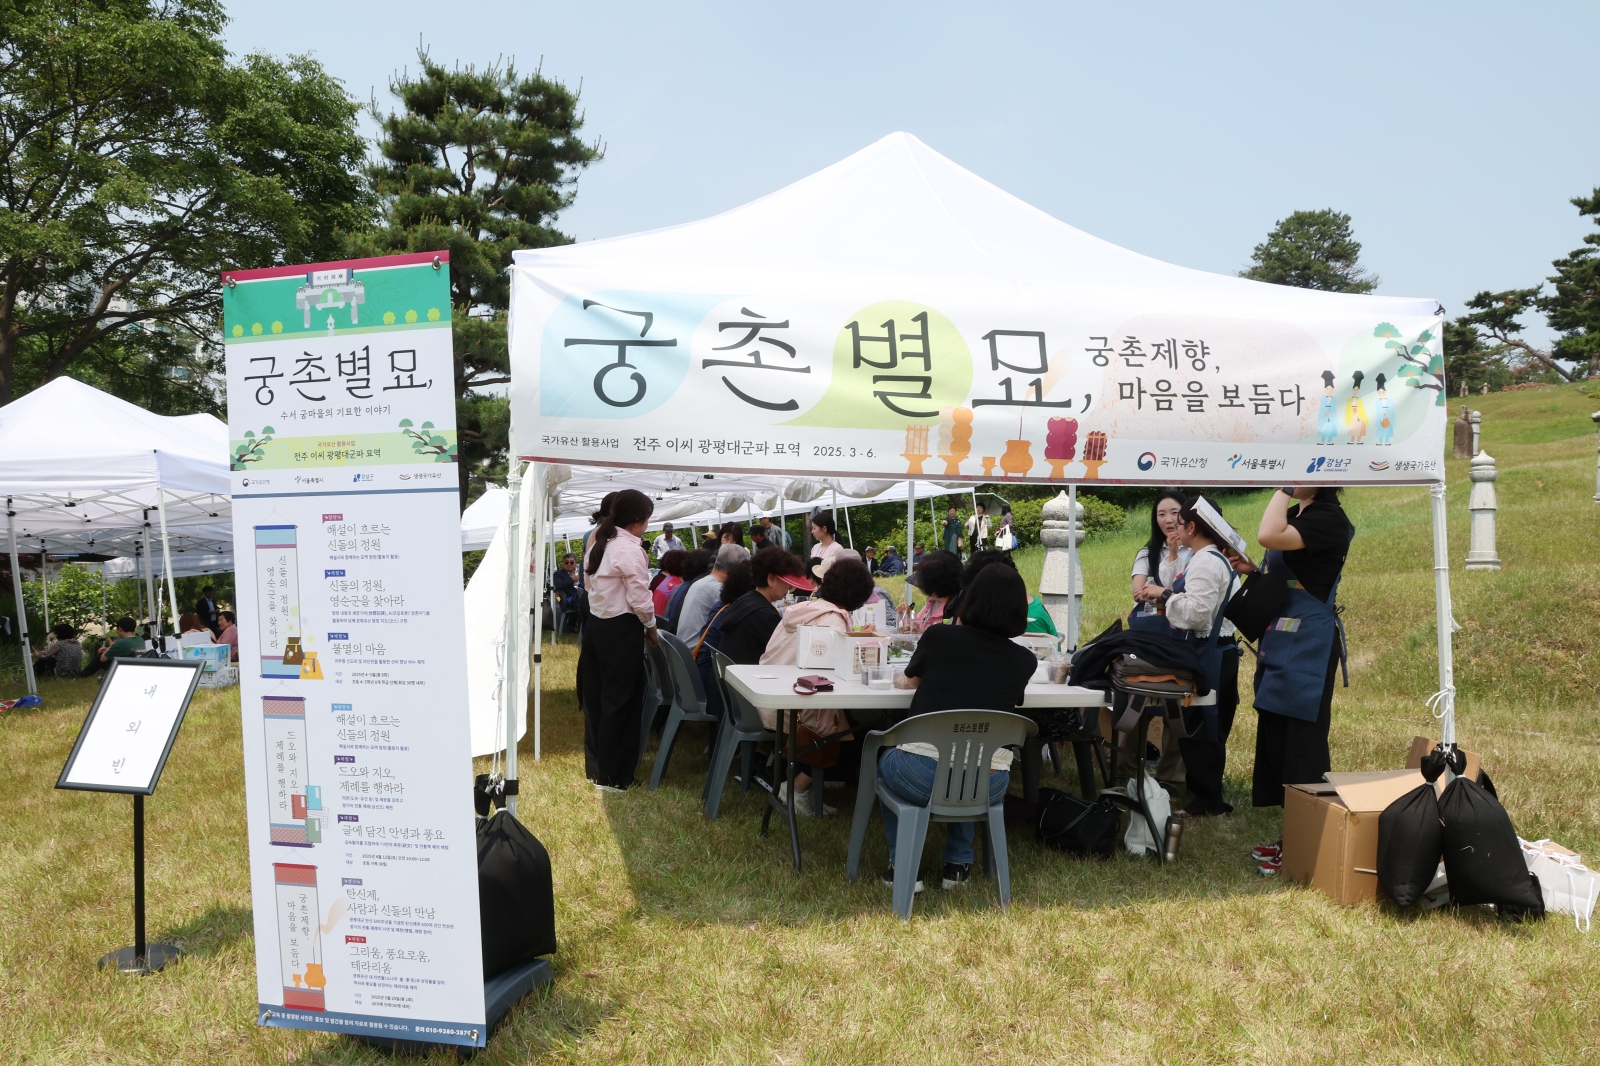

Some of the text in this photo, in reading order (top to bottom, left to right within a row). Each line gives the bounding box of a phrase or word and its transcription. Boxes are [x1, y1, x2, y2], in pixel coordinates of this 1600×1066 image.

[1084, 335, 1221, 373] 궁촌제향,
[244, 345, 433, 405] 궁촌별묘,
[1118, 376, 1306, 416] 마음을 보듬다
[280, 404, 391, 420] 수서 궁마을의 기묘한 이야기
[541, 434, 619, 449] 국가유산 활용사업
[633, 437, 801, 457] 전주 이씨 광평대군파 묘역
[294, 448, 381, 461] 전주 이씨 광평대군파 묘역
[814, 446, 846, 457] 2025.
[850, 447, 856, 457] 3
[867, 448, 876, 458] 6.
[1161, 456, 1208, 469] 국가유산청
[1241, 458, 1285, 470] 서울특별시
[1327, 459, 1352, 467] 강남구
[1395, 461, 1436, 471] 생생국가유산
[326, 524, 391, 536] 해설이 흐르는
[327, 539, 381, 551] 신들의 정원
[279, 555, 287, 588] 신들의
[329, 580, 385, 592] 신들의 정원,
[329, 595, 405, 607] 영순군을 찾아라
[269, 617, 278, 649] 찾아라
[332, 643, 386, 655] 불멸의 마음
[336, 714, 400, 727] 해설이 흐르는
[337, 729, 390, 742] 신들의 정원
[339, 766, 395, 780] 드오와 지오,
[340, 781, 404, 794] 제례를 행하라
[278, 779, 287, 810] 행하라
[342, 825, 445, 841] 글에 담긴 안녕과 풍요
[346, 888, 379, 901] 탄신제,
[381, 905, 411, 918] 신들의
[414, 907, 436, 920] 만남
[287, 901, 300, 969] 마음을 보듬다
[350, 946, 430, 963] 그리움, 풍요로움,
[351, 960, 392, 974] 테라리움
